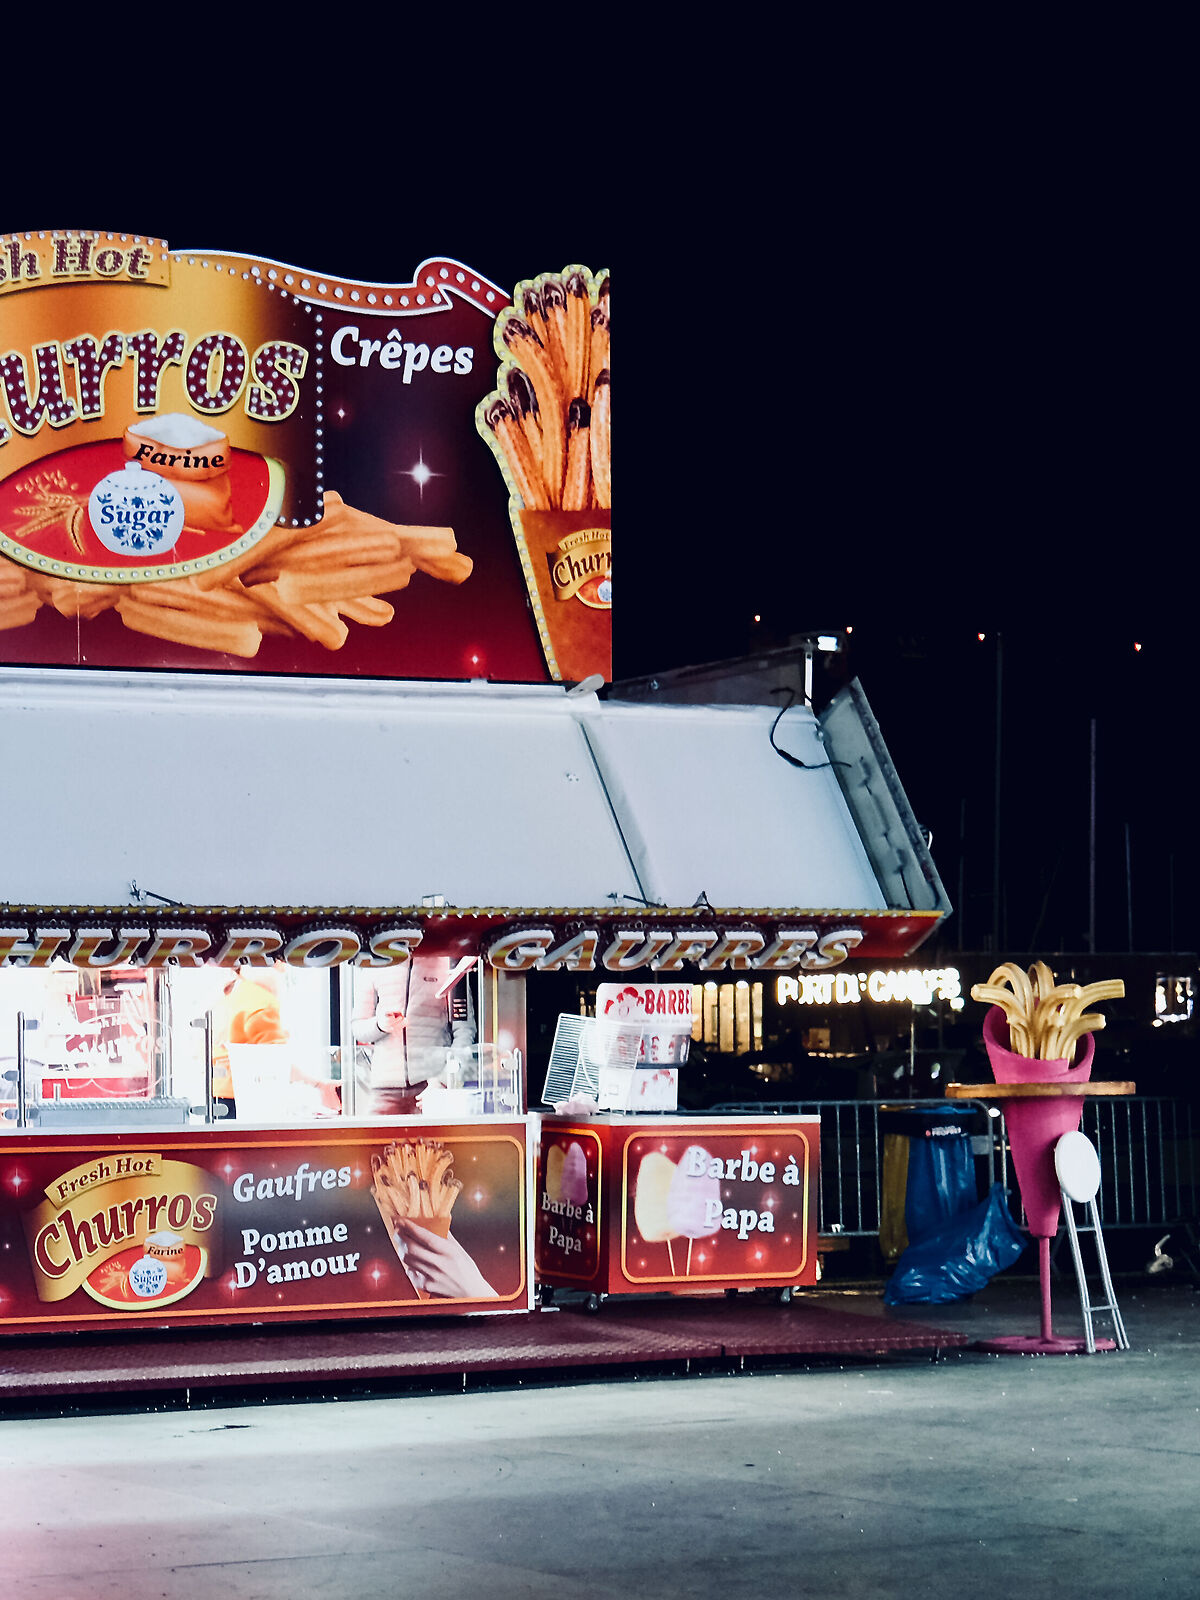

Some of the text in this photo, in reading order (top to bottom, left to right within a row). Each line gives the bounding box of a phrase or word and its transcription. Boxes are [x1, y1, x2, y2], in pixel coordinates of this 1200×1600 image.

[50, 236, 153, 280] Hot
[330, 325, 474, 384] Crêpes
[132, 443, 225, 469] Farine
[100, 504, 175, 531] Sugar
[486, 923, 865, 971] GAUFRES
[56, 1157, 155, 1201] Fresh Hot
[232, 1163, 352, 1203] Gaufres
[687, 1148, 800, 1187] Barbe à
[541, 1192, 595, 1225] Barbe à
[703, 1198, 775, 1241] Papa
[34, 1192, 218, 1280] Churros
[147, 1245, 183, 1256] Farine
[241, 1222, 349, 1256] Pomme
[548, 1225, 583, 1255] Papa
[133, 1273, 164, 1285] Sugar
[235, 1251, 361, 1289] D'amour
